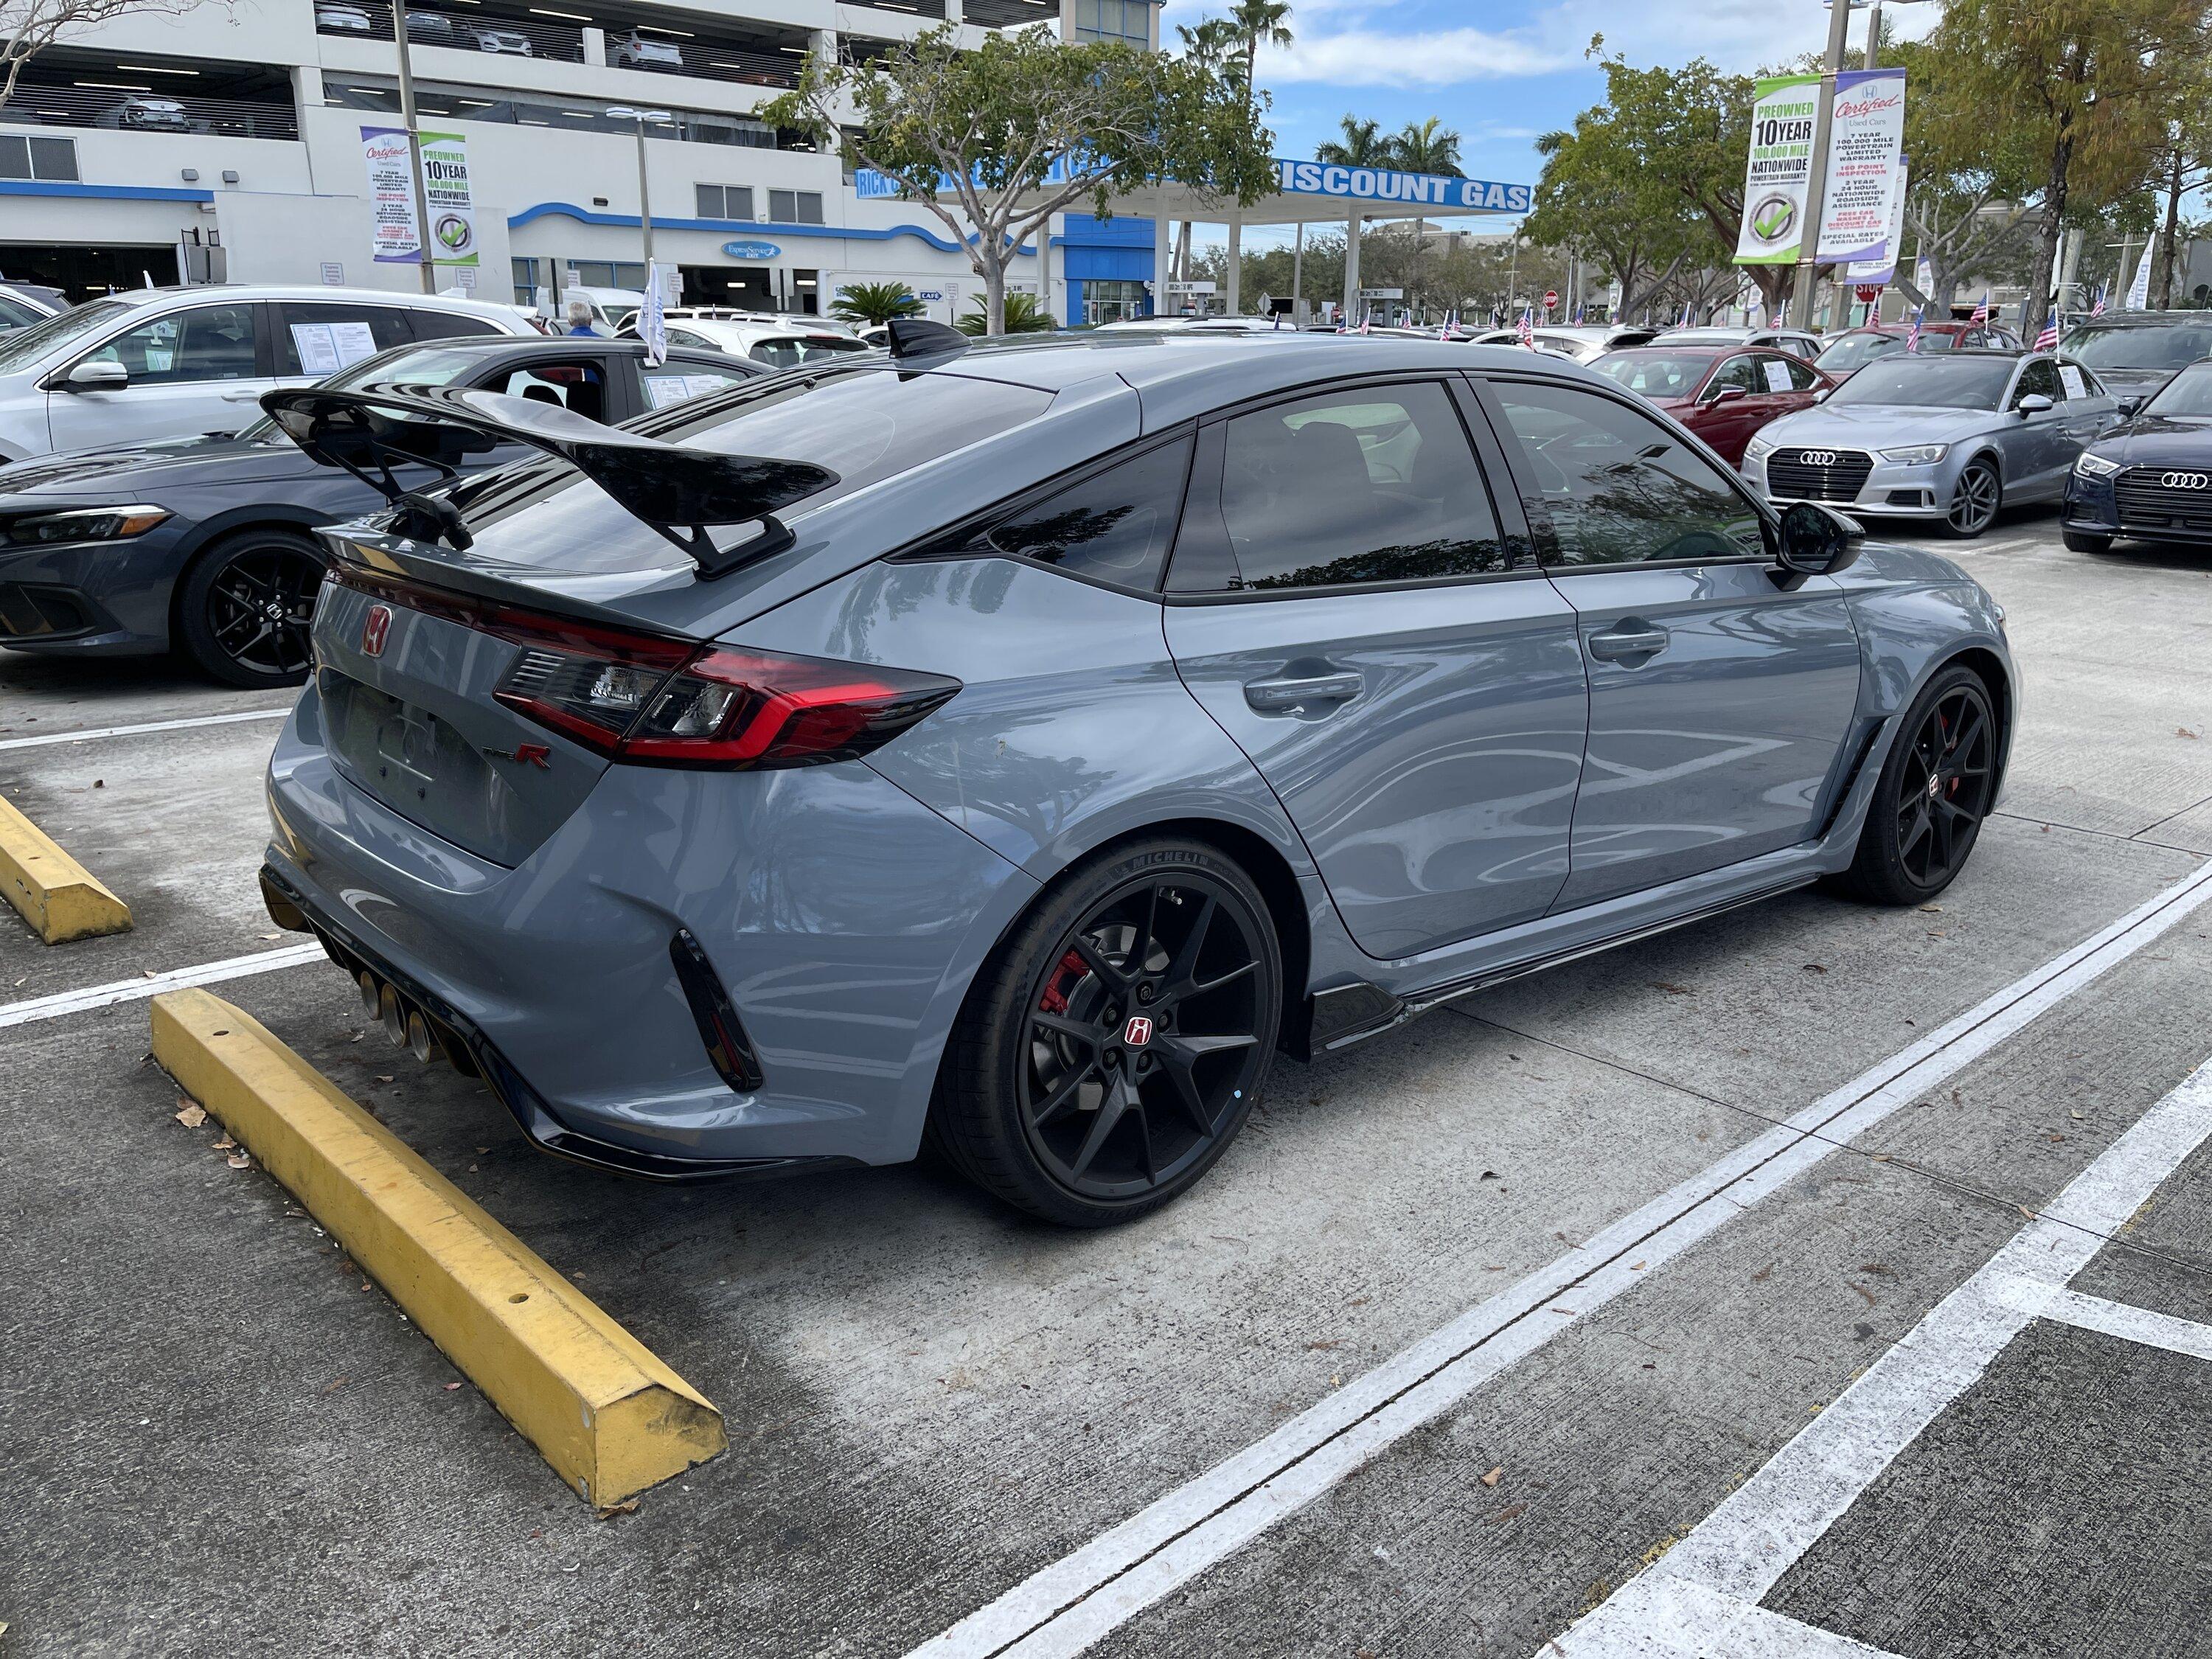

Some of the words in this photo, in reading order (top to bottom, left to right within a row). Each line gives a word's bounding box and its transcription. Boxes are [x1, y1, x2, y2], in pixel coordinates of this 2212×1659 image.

[1757, 102, 1814, 119] PREOWNED
[1835, 94, 1902, 118] Certified
[1756, 119, 1778, 146] 10
[1778, 121, 1812, 142] YEAR
[366, 147, 408, 160] Certified
[423, 150, 465, 162] PREOWNED
[1790, 144, 1809, 157] MILE
[425, 161, 442, 180] 10
[442, 164, 467, 179] YEAR
[1751, 159, 1808, 174] NATIONWIDE
[454, 182, 468, 191] MILE
[858, 170, 887, 195] RICK
[1274, 161, 1451, 204] ISCOUNT
[1461, 181, 1529, 212] GAS
[428, 189, 470, 201] NATIONWIDE
[1857, 285, 1883, 293] STOP
[1133, 851, 1209, 869] MICHELIN
